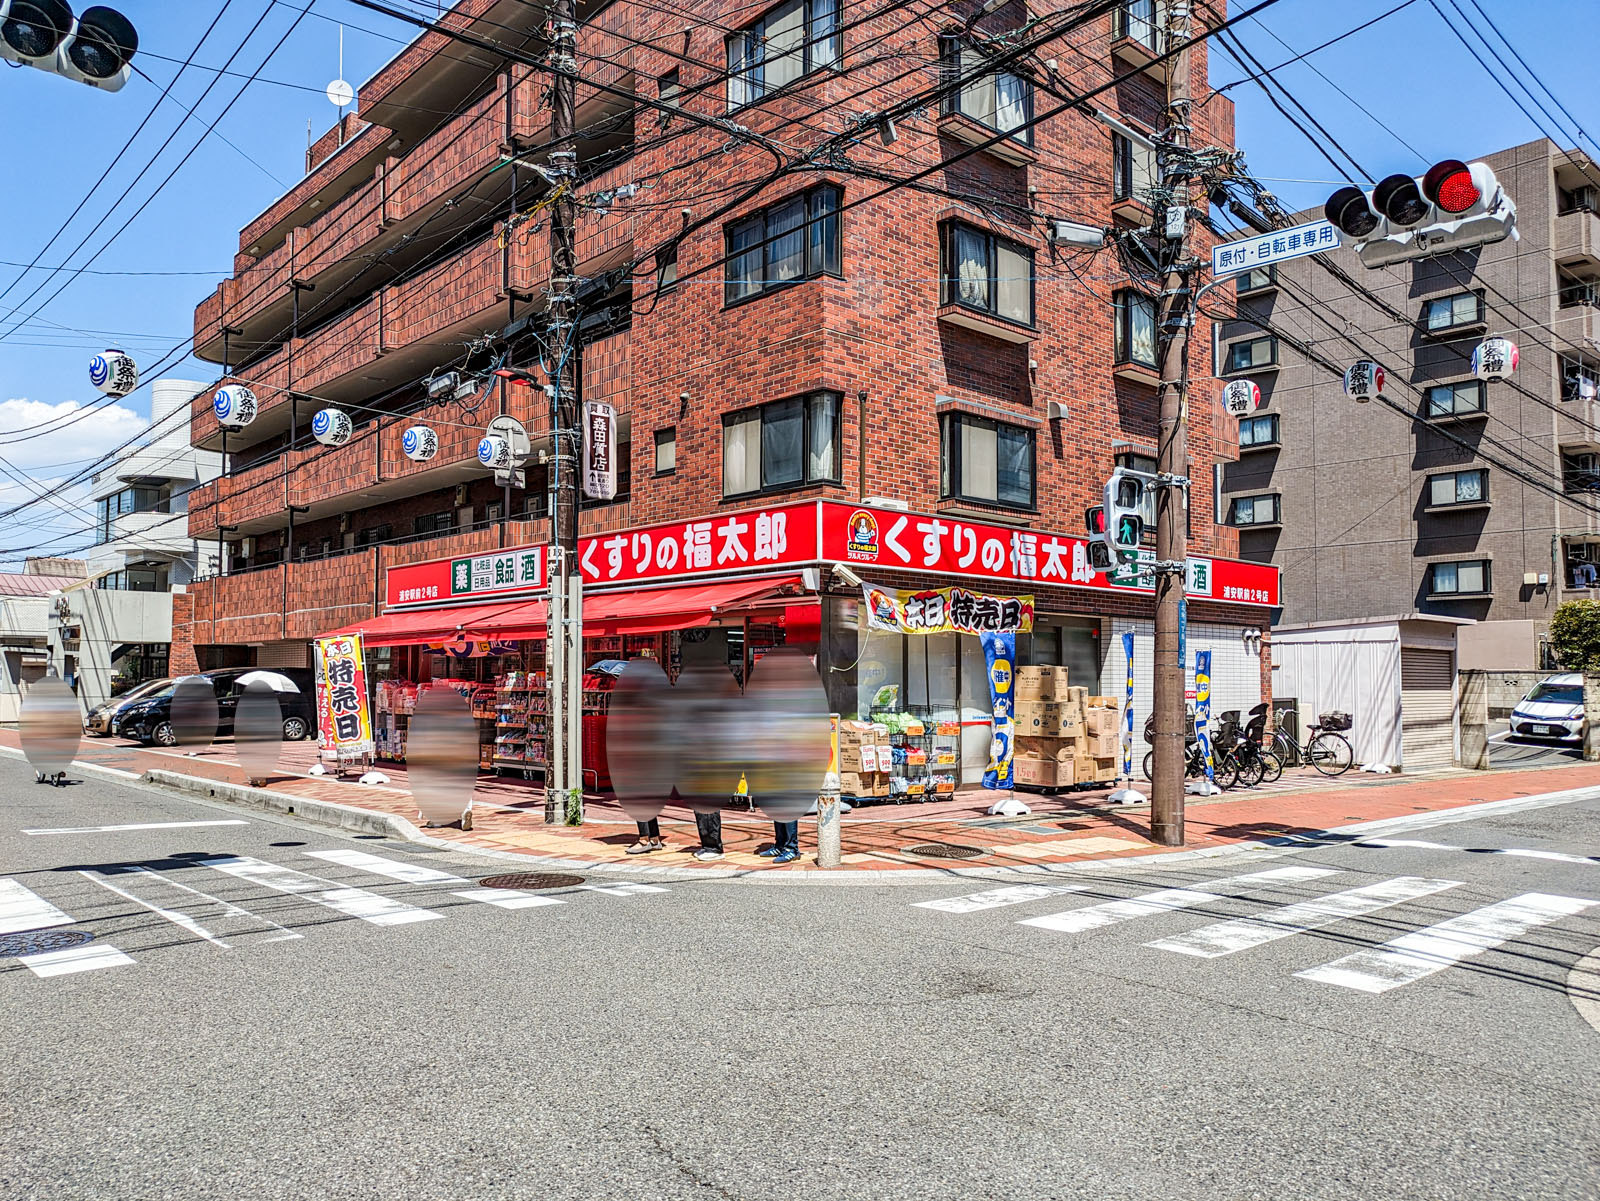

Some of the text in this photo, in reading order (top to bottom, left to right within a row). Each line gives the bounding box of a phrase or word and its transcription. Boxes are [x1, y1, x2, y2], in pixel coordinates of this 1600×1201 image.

[1219, 225, 1333, 268] 原付・自転車専用
[592, 417, 607, 471] 森田質店
[581, 512, 787, 580] くすりの福太郎
[456, 563, 468, 590] 薬
[474, 558, 491, 571] 化粧品
[495, 558, 514, 585] 食品
[521, 553, 535, 582] 酒
[1193, 564, 1207, 591] 酒
[399, 585, 439, 602] 浦安駅前2号店
[474, 576, 491, 589] 日用品
[1223, 585, 1269, 603] 浦安駅前2号店
[904, 589, 1021, 631] 本日 特売日
[326, 641, 352, 658] 本日
[328, 658, 360, 740] 特売日
